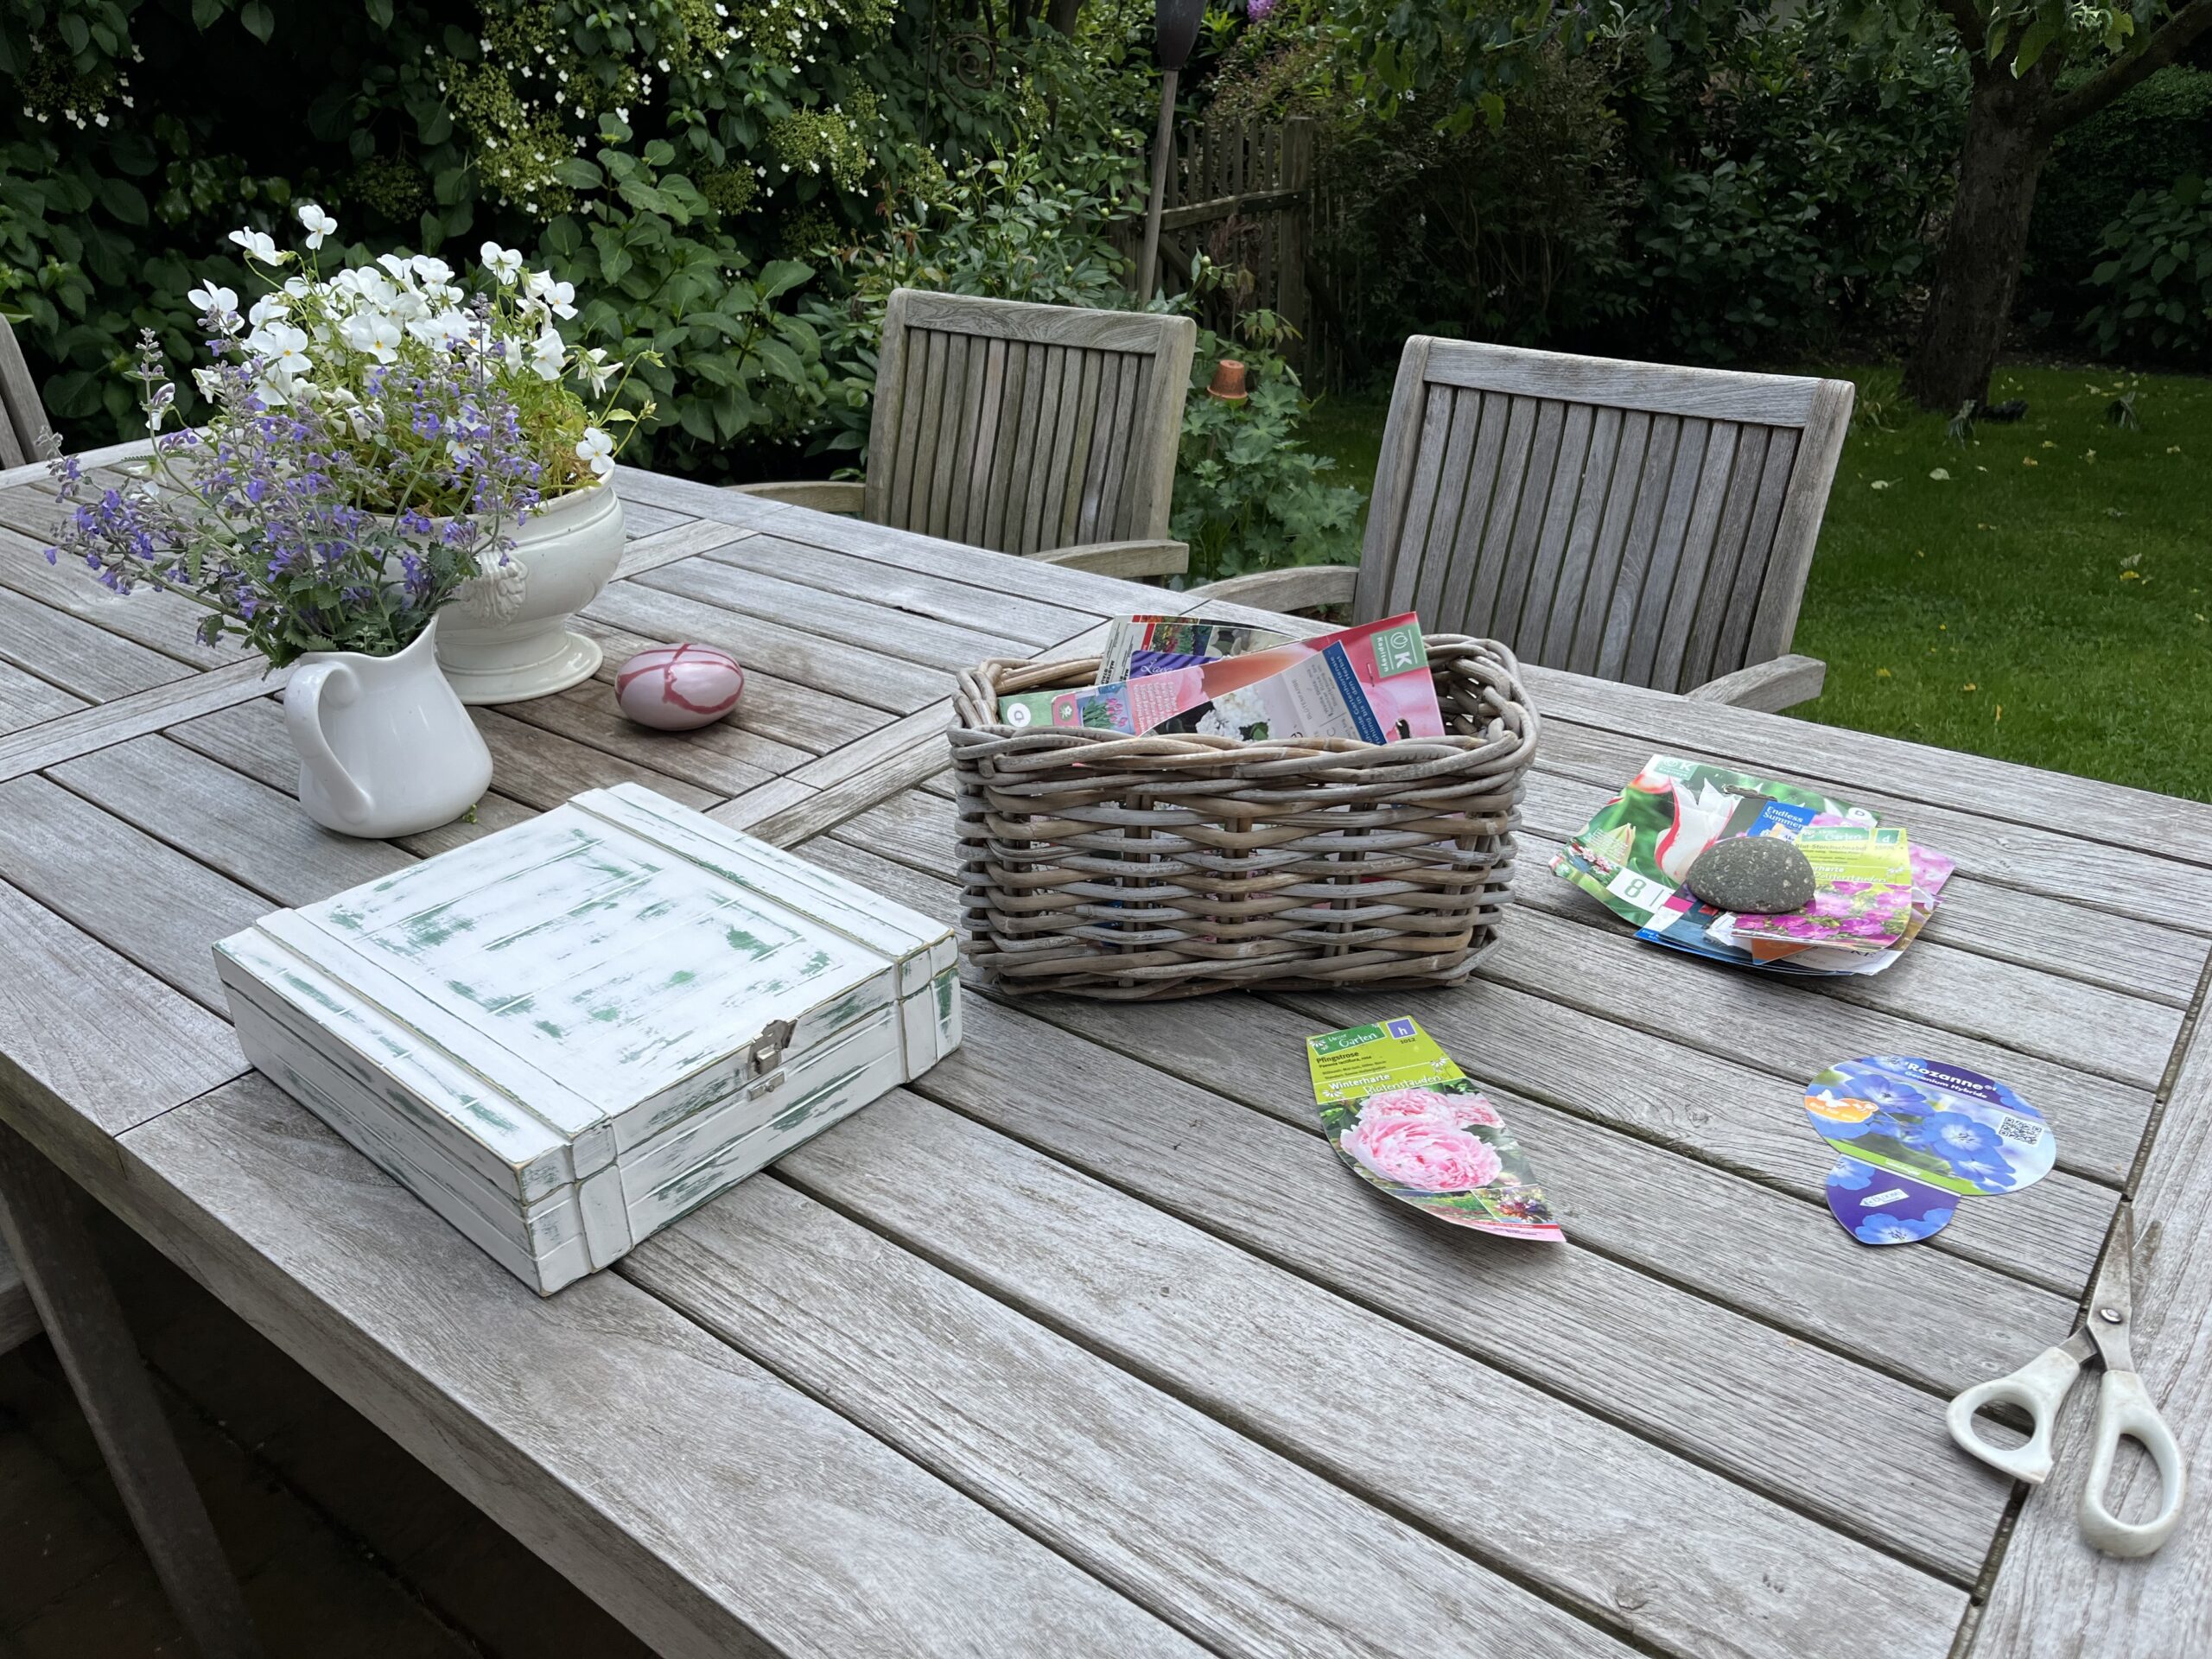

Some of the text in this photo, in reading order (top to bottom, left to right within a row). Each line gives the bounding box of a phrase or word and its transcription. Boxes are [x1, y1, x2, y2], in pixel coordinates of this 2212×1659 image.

[1376, 636, 1389, 672] Kapiteyn
[1395, 652, 1413, 669] K
[1014, 712, 1026, 721] D
[1764, 811, 1803, 830] Summer
[1766, 806, 1803, 823] Endless
[1825, 832, 1862, 841] Garten
[1882, 835, 1890, 843] d
[1624, 878, 1646, 898] 8
[1398, 1027, 1408, 1036] h
[1338, 1033, 1377, 1047] Garten
[1316, 1051, 1359, 1064] Pfingstrose
[1329, 1074, 1391, 1090] Winterharte
[1904, 1071, 1988, 1099] Geranium Hybride
